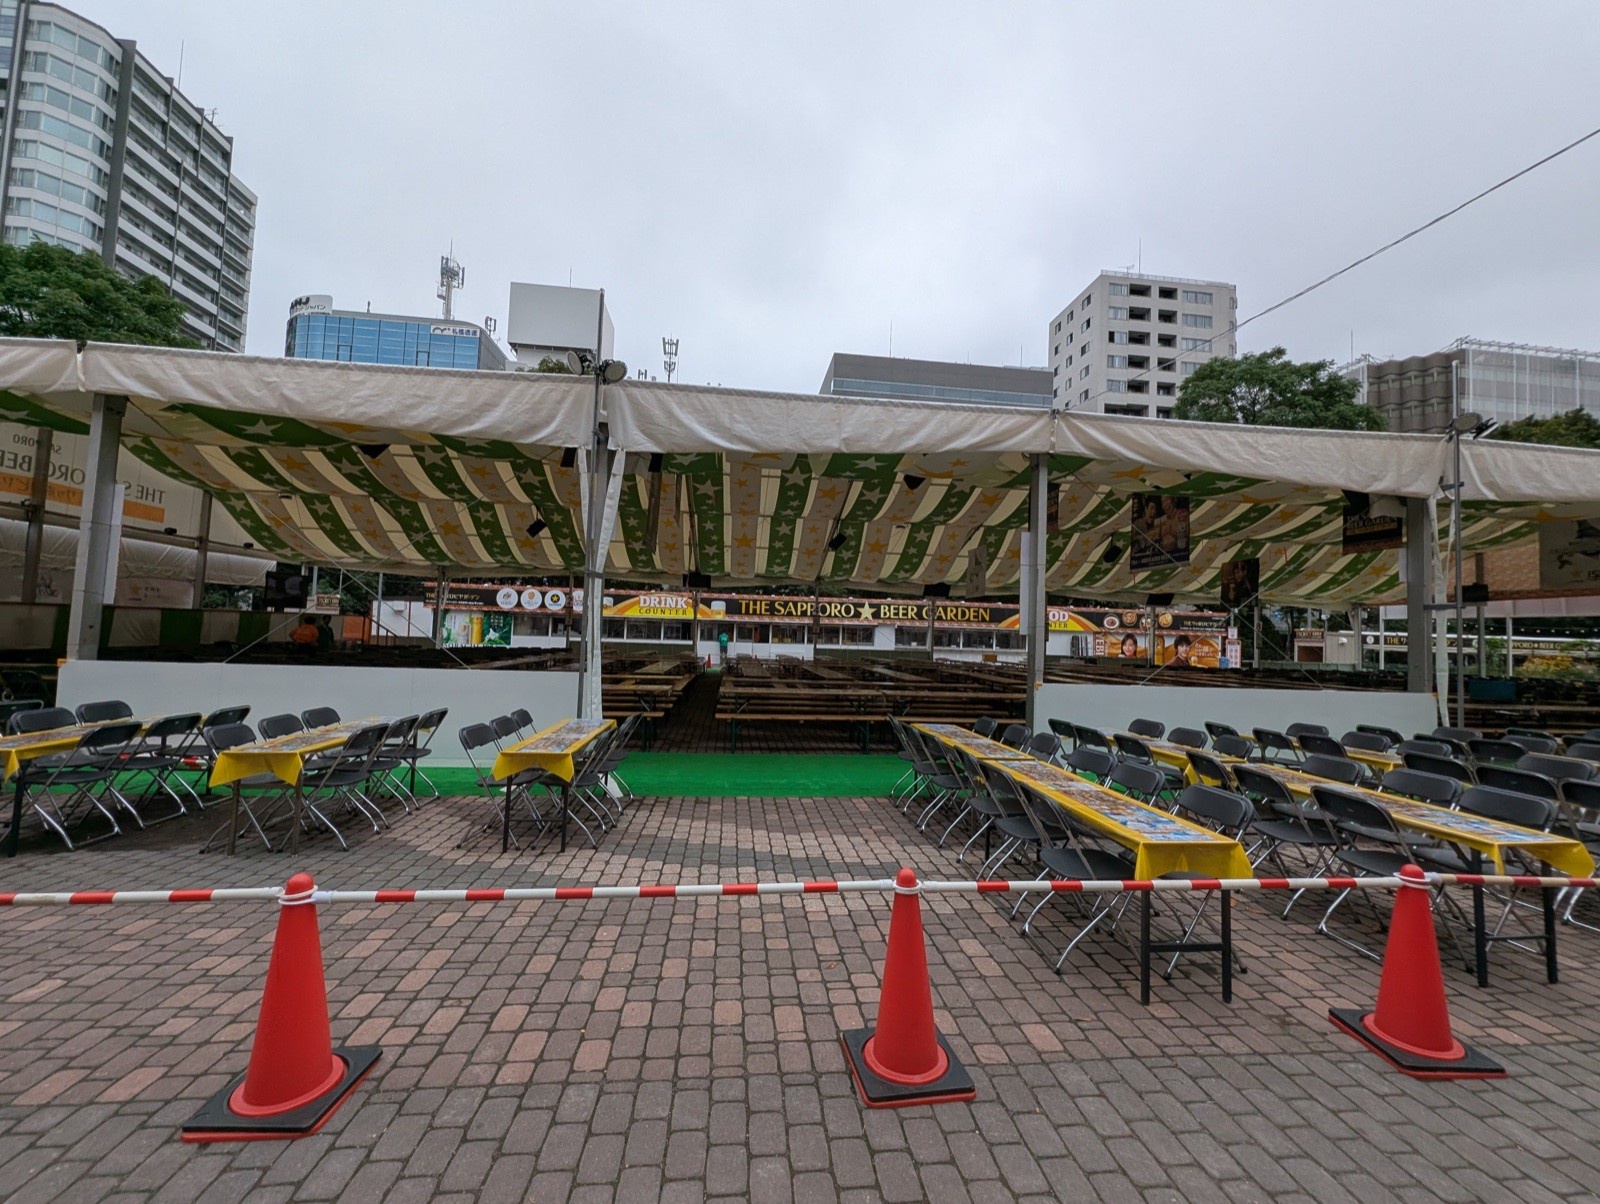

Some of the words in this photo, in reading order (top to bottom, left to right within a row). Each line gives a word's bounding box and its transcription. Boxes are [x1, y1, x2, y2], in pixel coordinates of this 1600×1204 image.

[639, 595, 688, 609] DRINK
[639, 607, 688, 616] COUNTER
[738, 600, 771, 615] THE
[774, 601, 855, 618] SAPPORO
[880, 604, 919, 620] BEER
